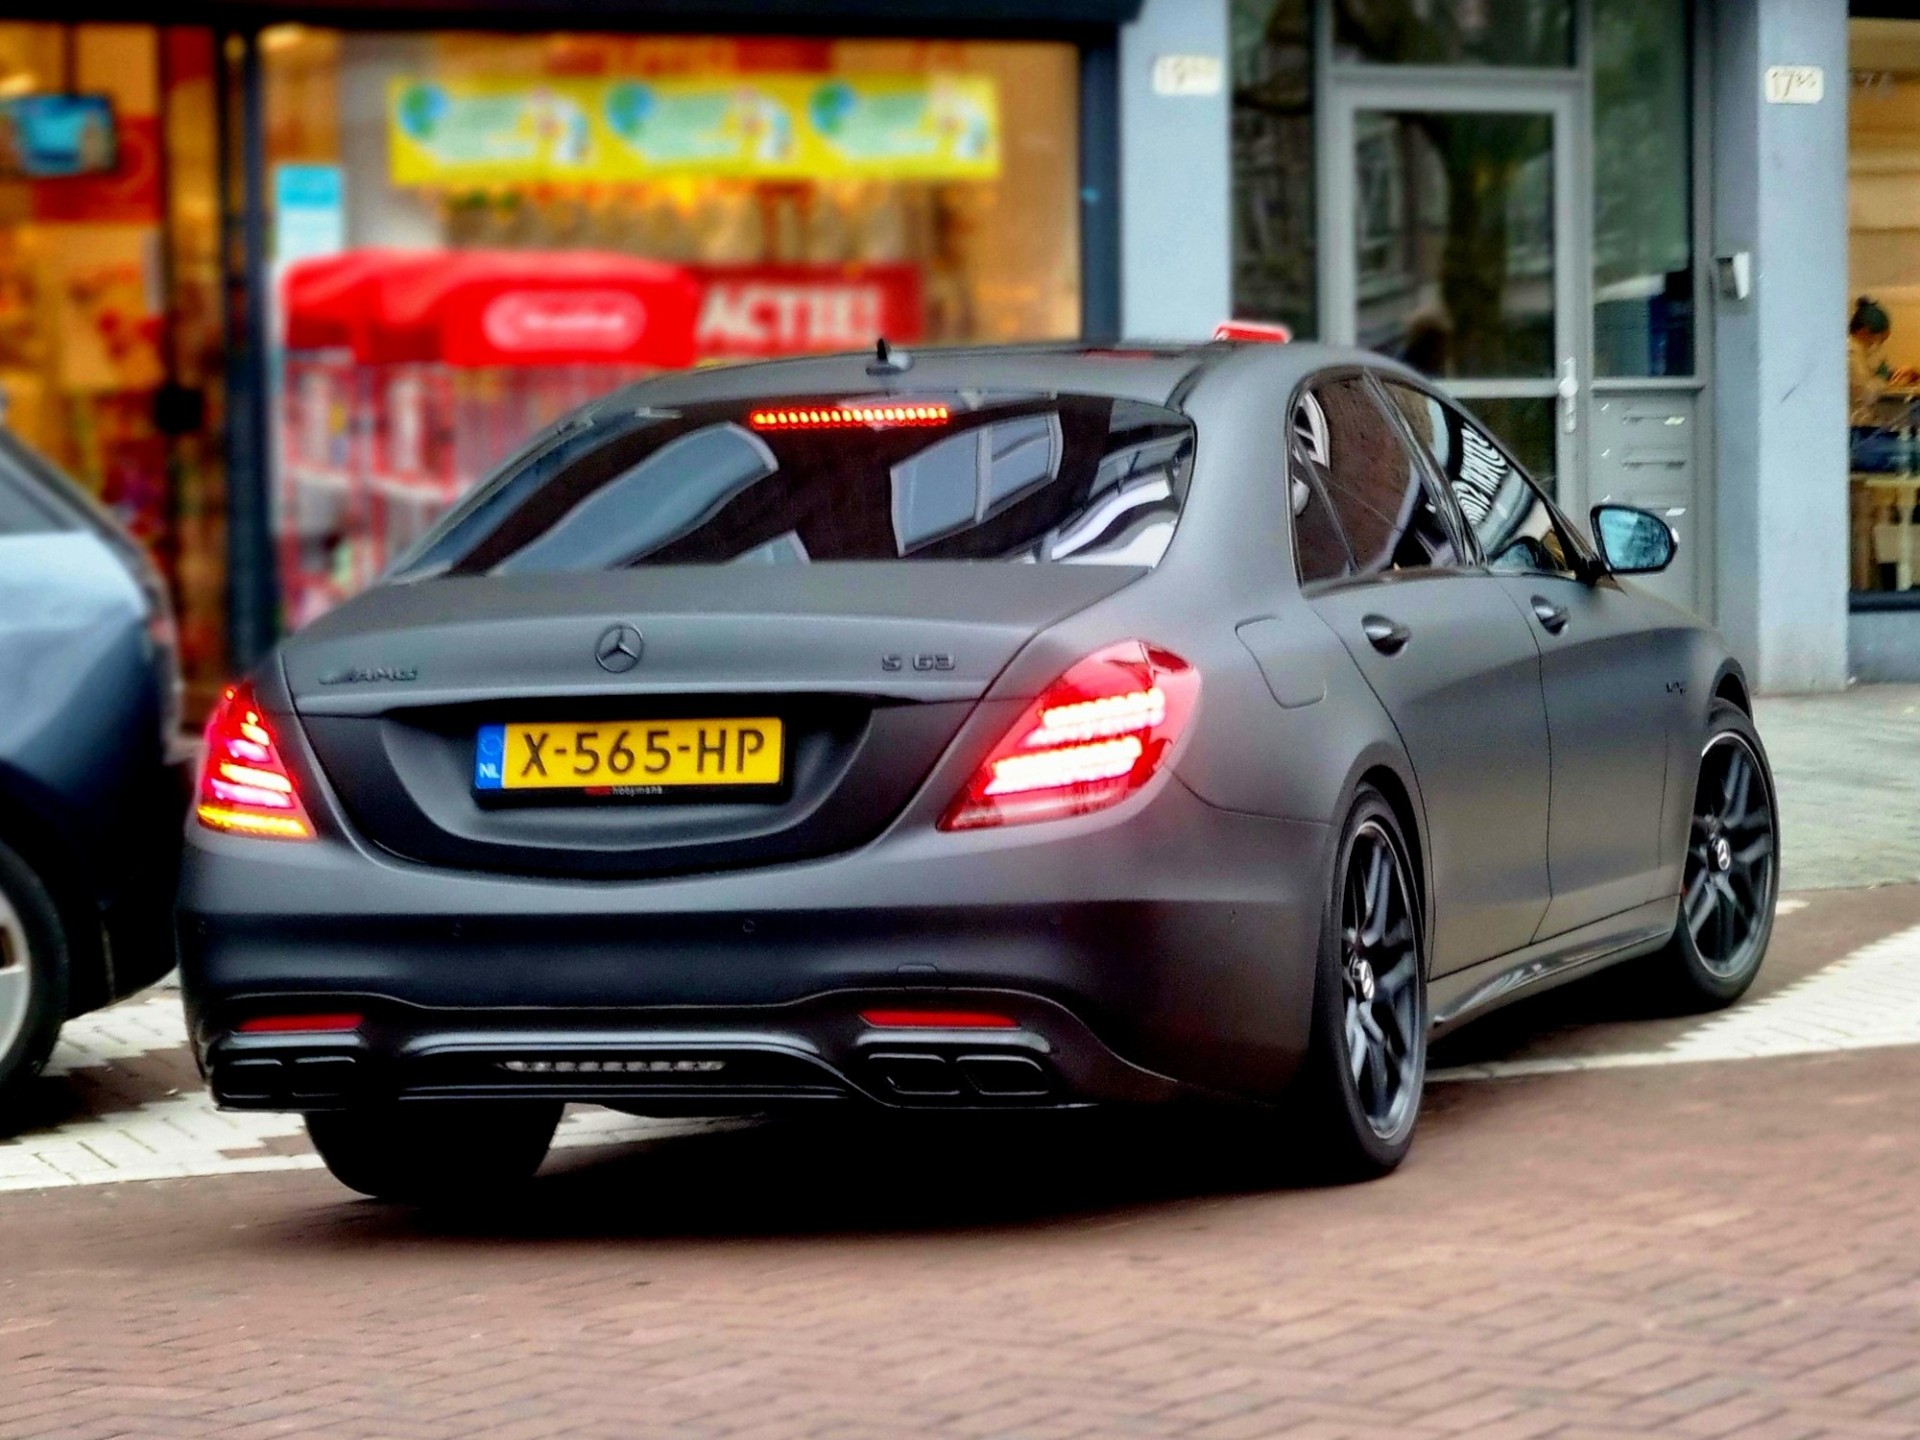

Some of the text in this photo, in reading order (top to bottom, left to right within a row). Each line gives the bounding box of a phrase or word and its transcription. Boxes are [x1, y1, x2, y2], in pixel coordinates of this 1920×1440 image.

[696, 284, 882, 341] ACTIE!
[881, 653, 956, 672] S 63
[479, 761, 501, 779] NL
[520, 727, 765, 778] X-565-HP
